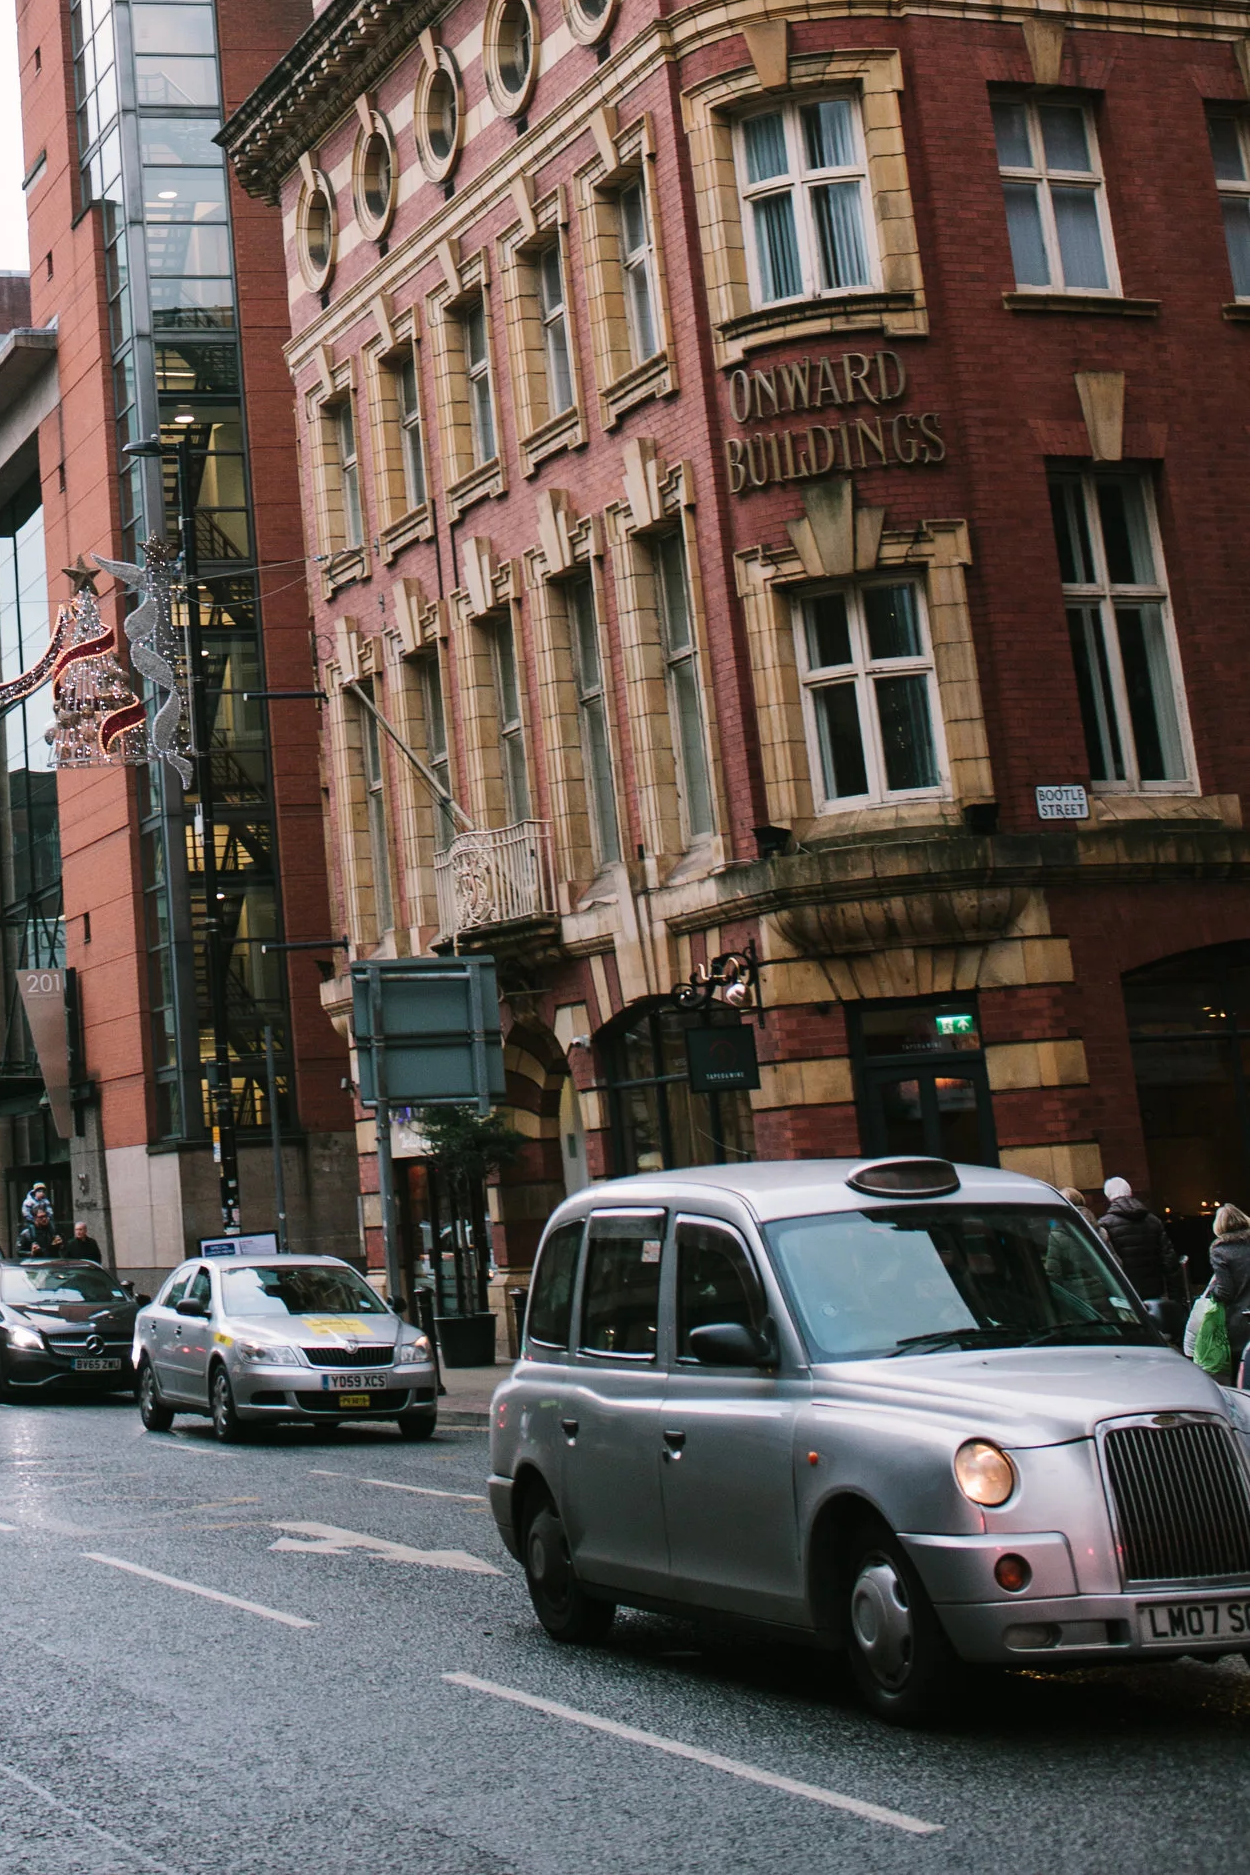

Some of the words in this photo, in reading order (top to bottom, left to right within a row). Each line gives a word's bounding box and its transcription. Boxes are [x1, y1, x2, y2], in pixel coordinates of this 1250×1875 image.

[729, 350, 906, 423] ONWARD
[724, 412, 947, 494] BUILDINGS
[1037, 788, 1084, 801] BOOTLE
[1041, 804, 1085, 816] STREET
[26, 974, 61, 993] 201
[364, 1375, 385, 1387] XCS
[1148, 1605, 1219, 1638] LM07
